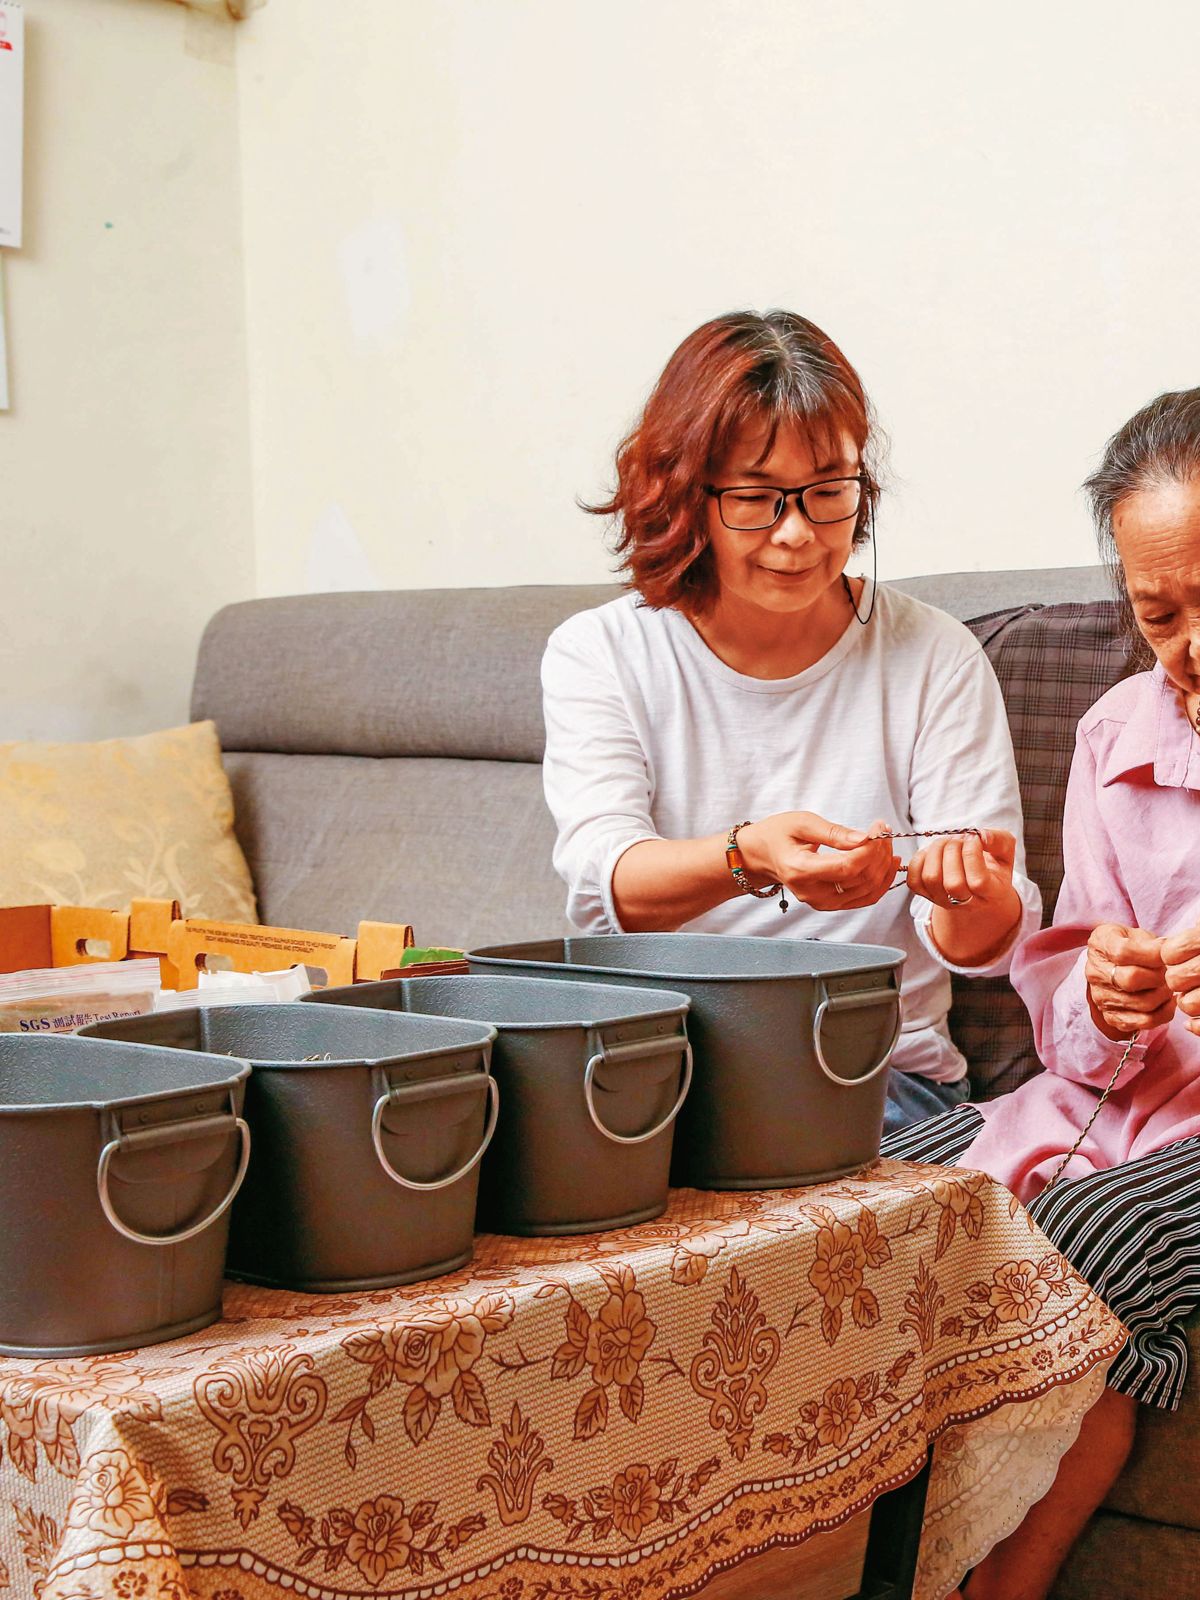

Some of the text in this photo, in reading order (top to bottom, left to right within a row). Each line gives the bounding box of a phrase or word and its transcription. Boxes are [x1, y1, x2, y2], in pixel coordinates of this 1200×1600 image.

[20, 1017, 50, 1032] SGS
[53, 1013, 92, 1028] 測試報告
[93, 1013, 112, 1021] Test
